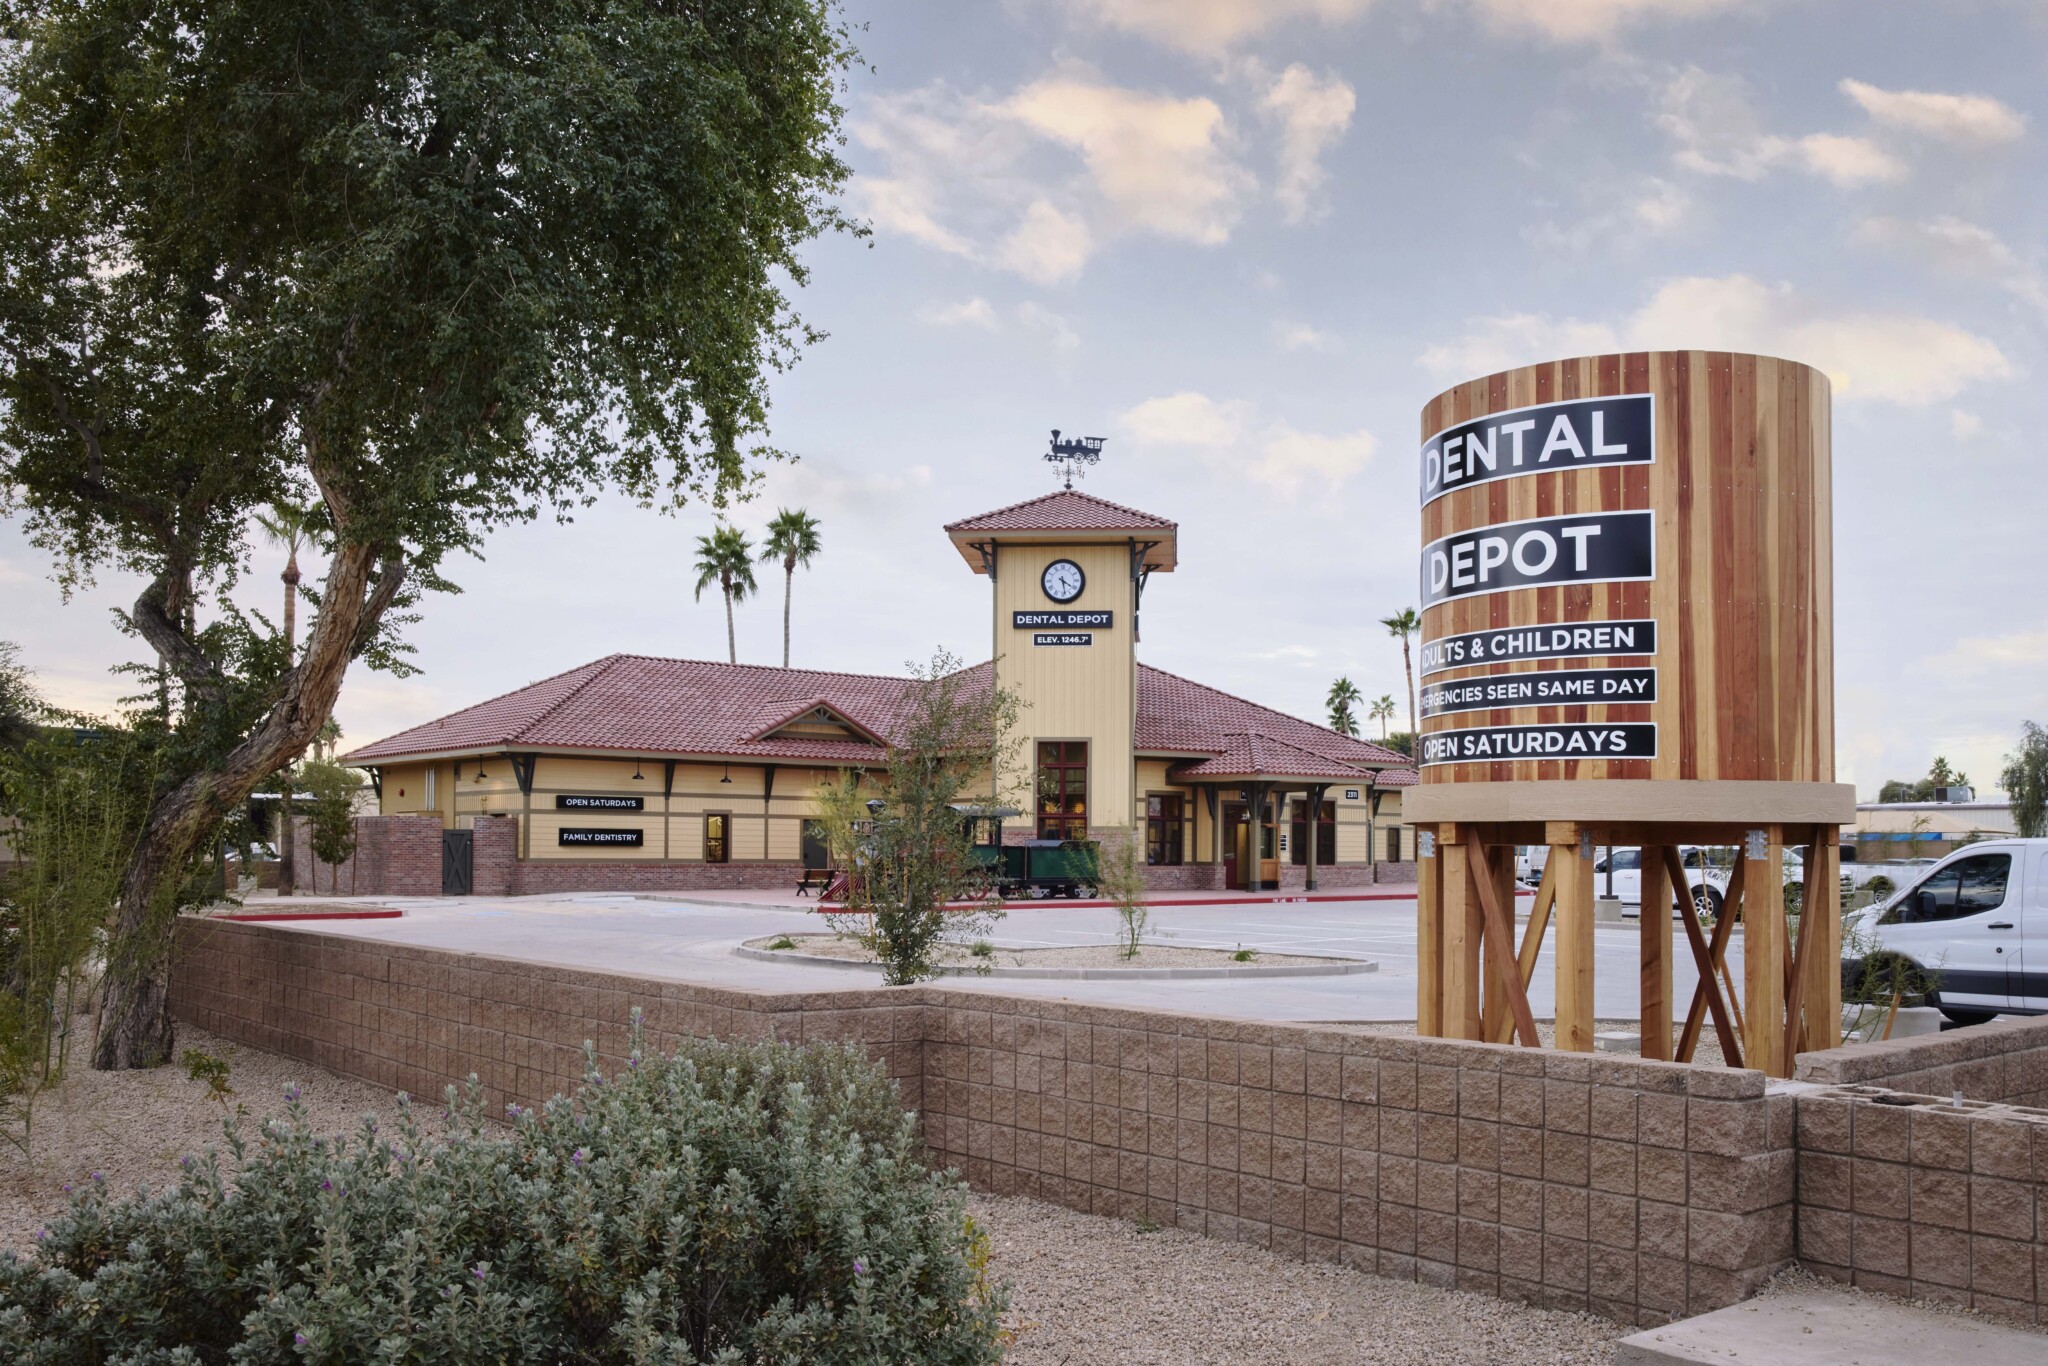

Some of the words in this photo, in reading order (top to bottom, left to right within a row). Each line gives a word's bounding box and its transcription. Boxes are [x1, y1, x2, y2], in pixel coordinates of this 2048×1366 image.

[1426, 410, 1628, 493] DENTAL
[1431, 524, 1601, 595] DEPOT
[1016, 615, 1065, 624] DENTAL
[1067, 614, 1109, 624] DEPOT
[1037, 636, 1060, 644] ELEV.
[1470, 637, 1484, 658] &
[1490, 626, 1635, 655] CHILDREN
[1486, 681, 1532, 700] SEEN
[1537, 679, 1595, 697] SAME
[1602, 678, 1648, 694] DAY
[1424, 736, 1458, 760] OPEN
[1463, 730, 1627, 755] SATURDAYS
[589, 799, 636, 807] SATURDAYS
